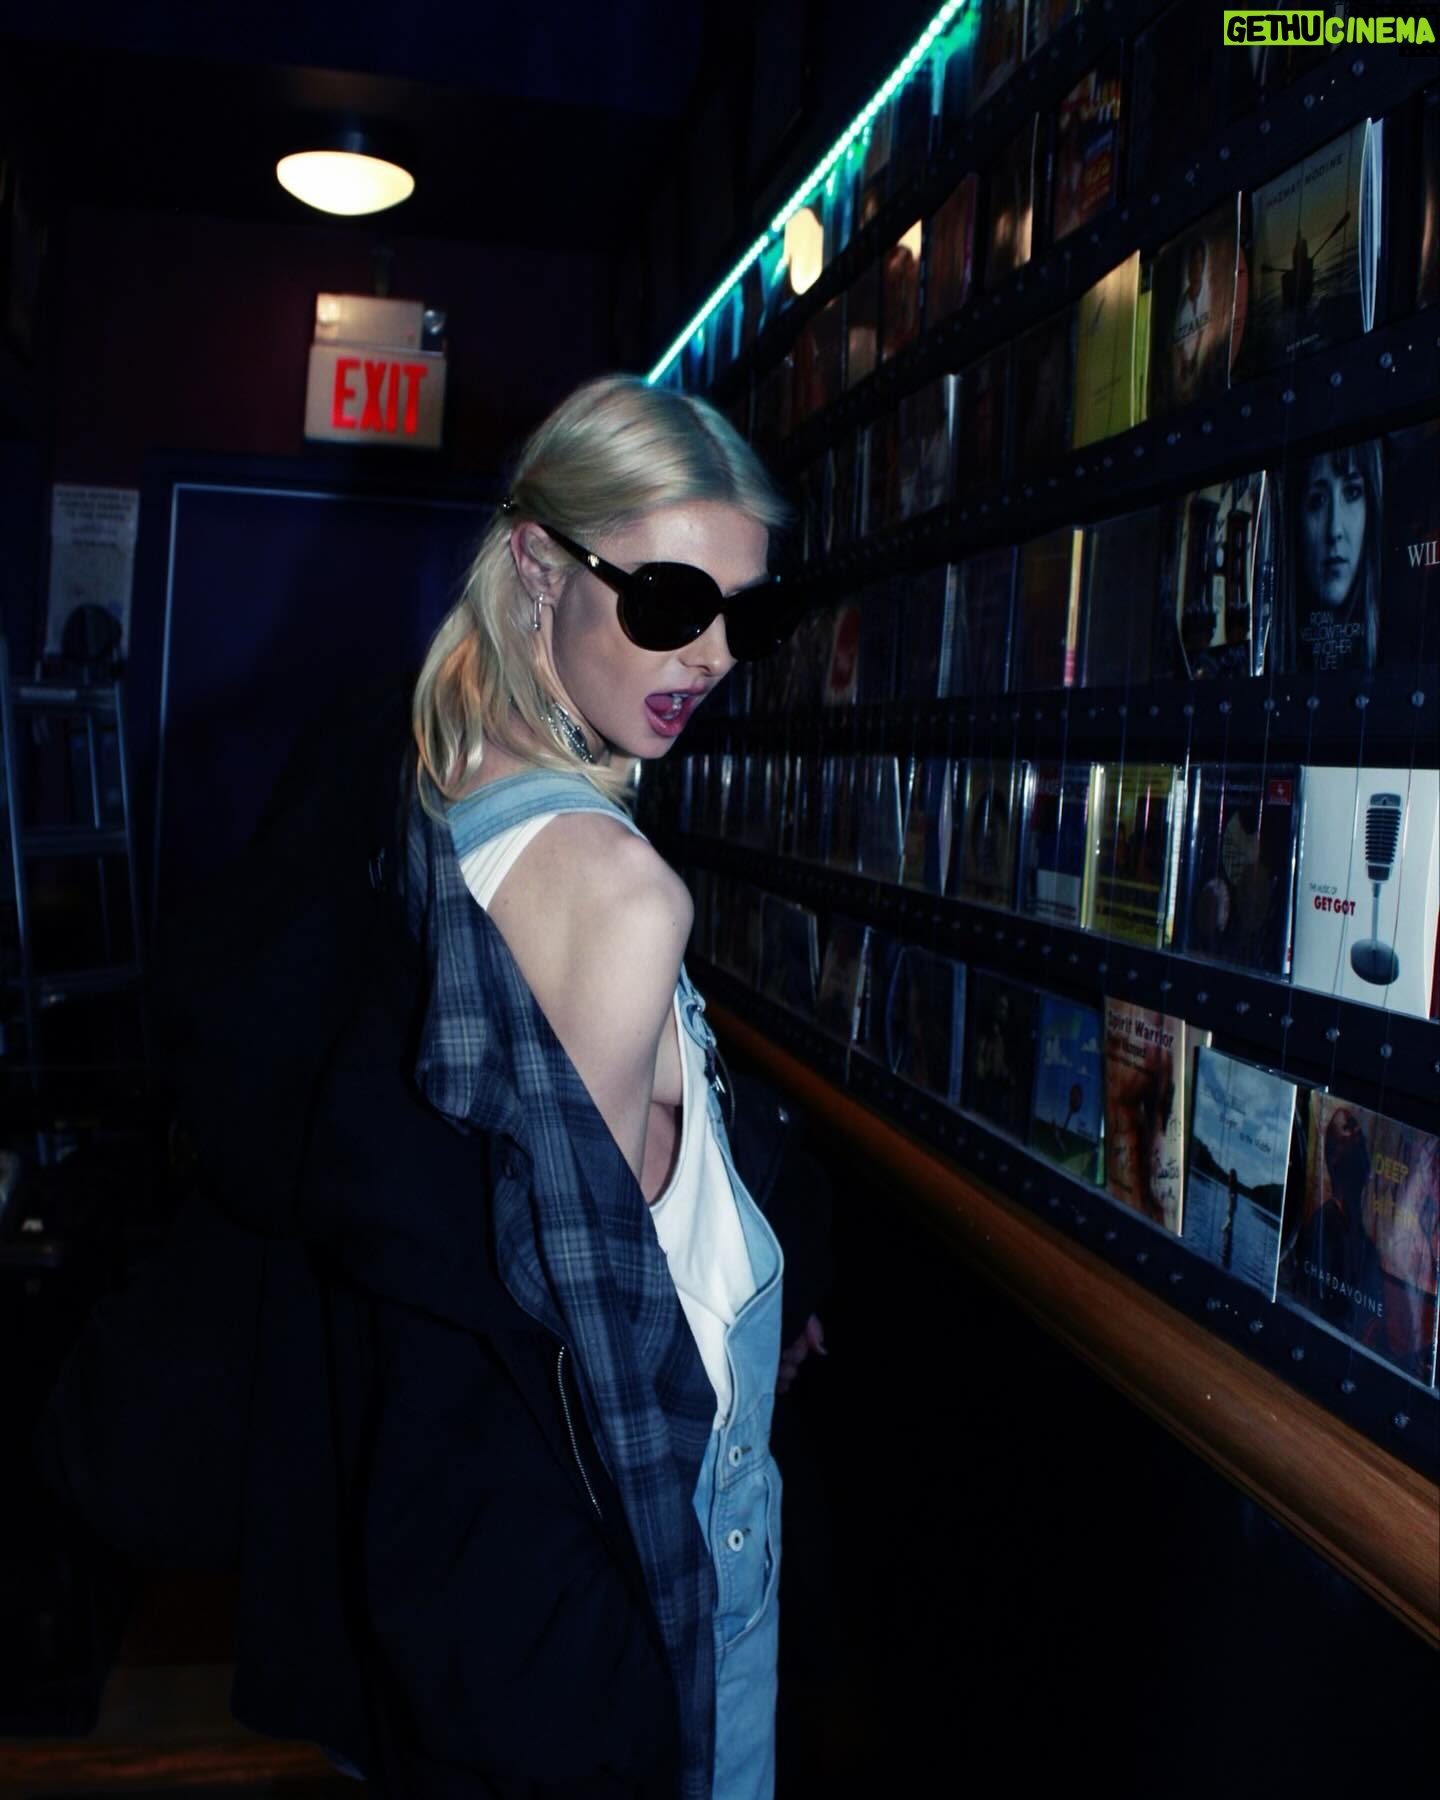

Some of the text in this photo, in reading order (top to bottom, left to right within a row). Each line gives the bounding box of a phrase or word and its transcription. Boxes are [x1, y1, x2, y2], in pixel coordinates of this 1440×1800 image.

[332, 358, 428, 435] EXIT
[1314, 895, 1356, 916] GET GOT
[1375, 1152, 1409, 1185] DEEP
[1303, 1258, 1384, 1318] CHARDAVOINE
